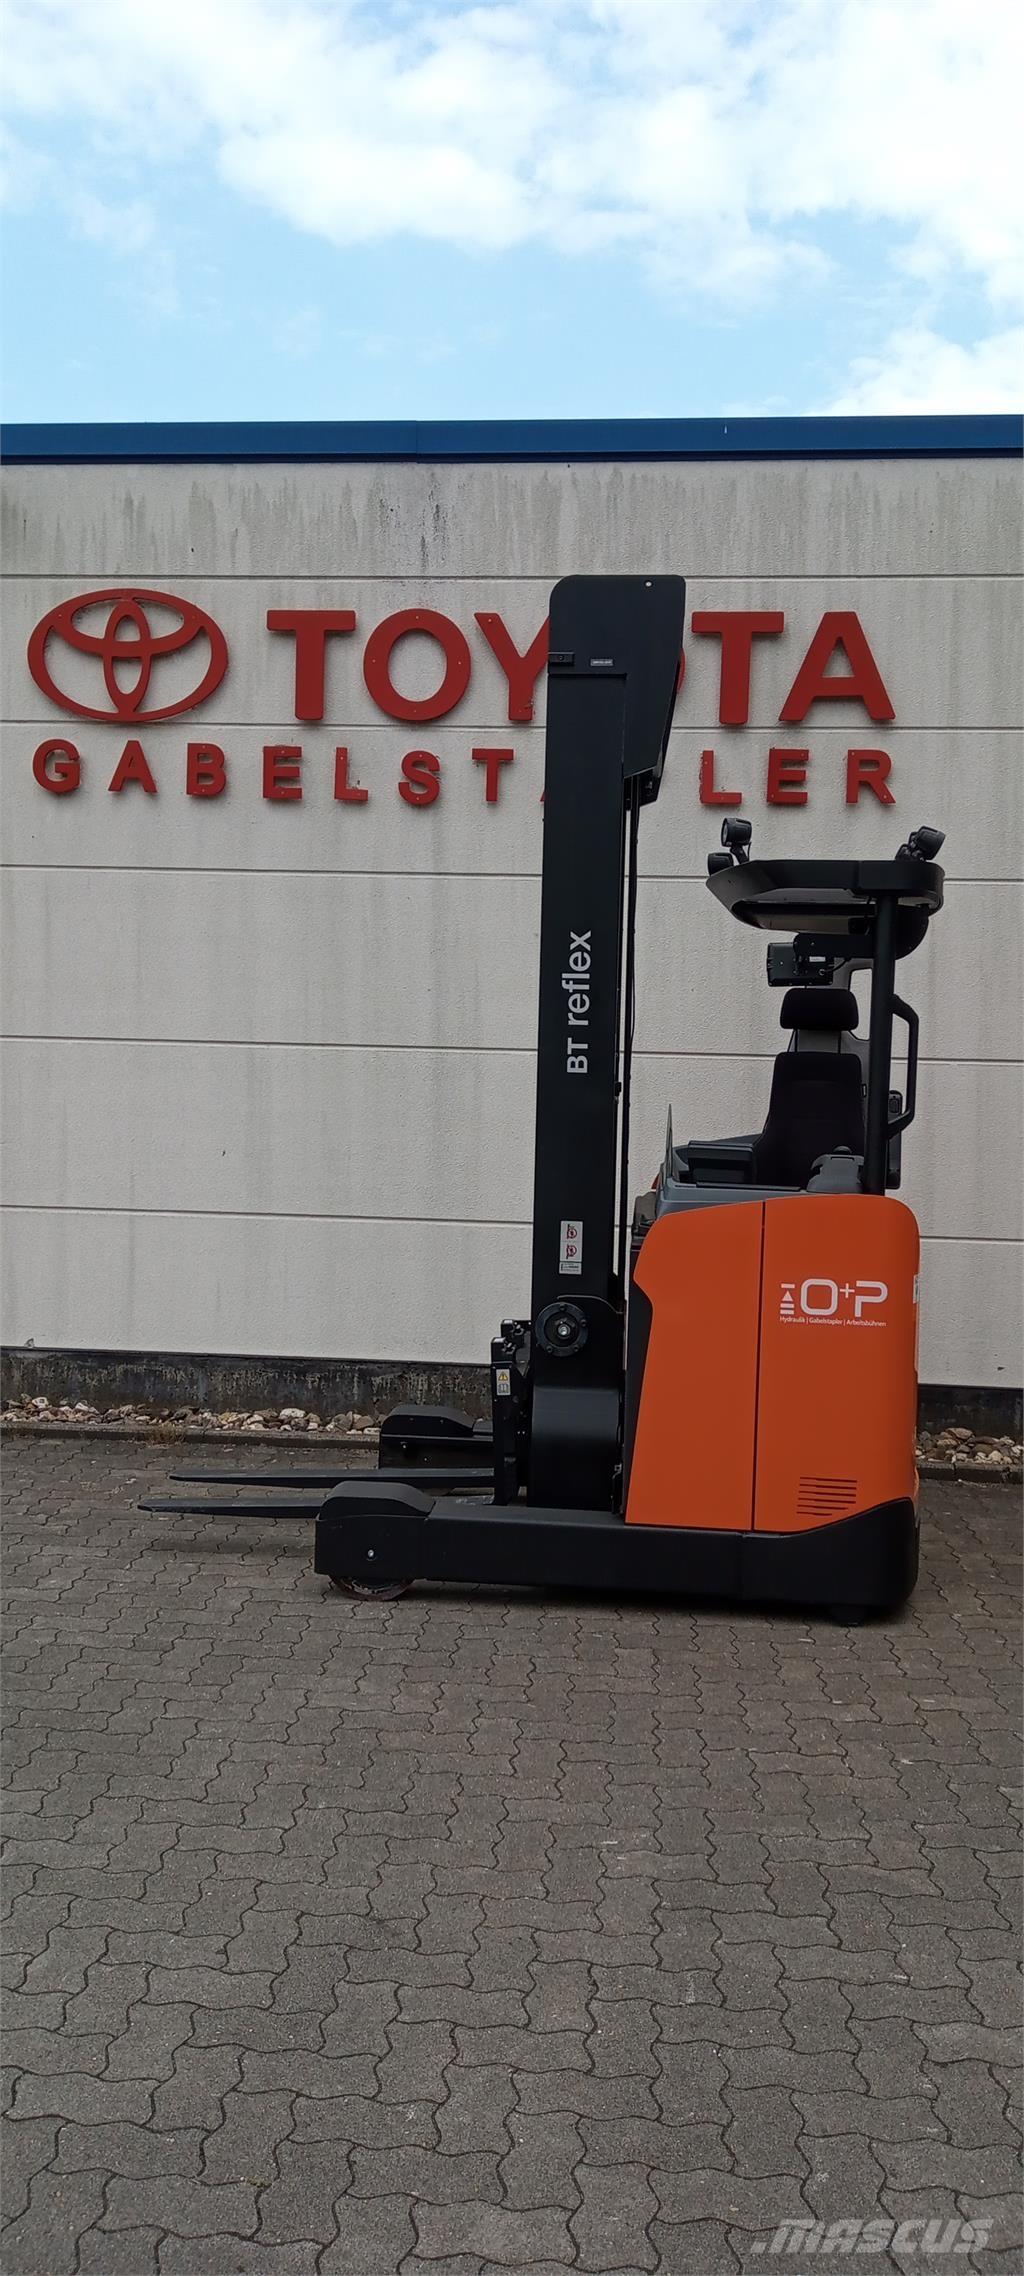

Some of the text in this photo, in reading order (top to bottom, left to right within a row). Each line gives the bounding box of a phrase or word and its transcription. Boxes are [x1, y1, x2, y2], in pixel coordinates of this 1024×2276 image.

[267, 608, 896, 724] TOYTA
[32, 738, 896, 806] GABELSTLER
[561, 930, 592, 1074] BT reflex
[808, 1318, 843, 1326] Gabelstapler
